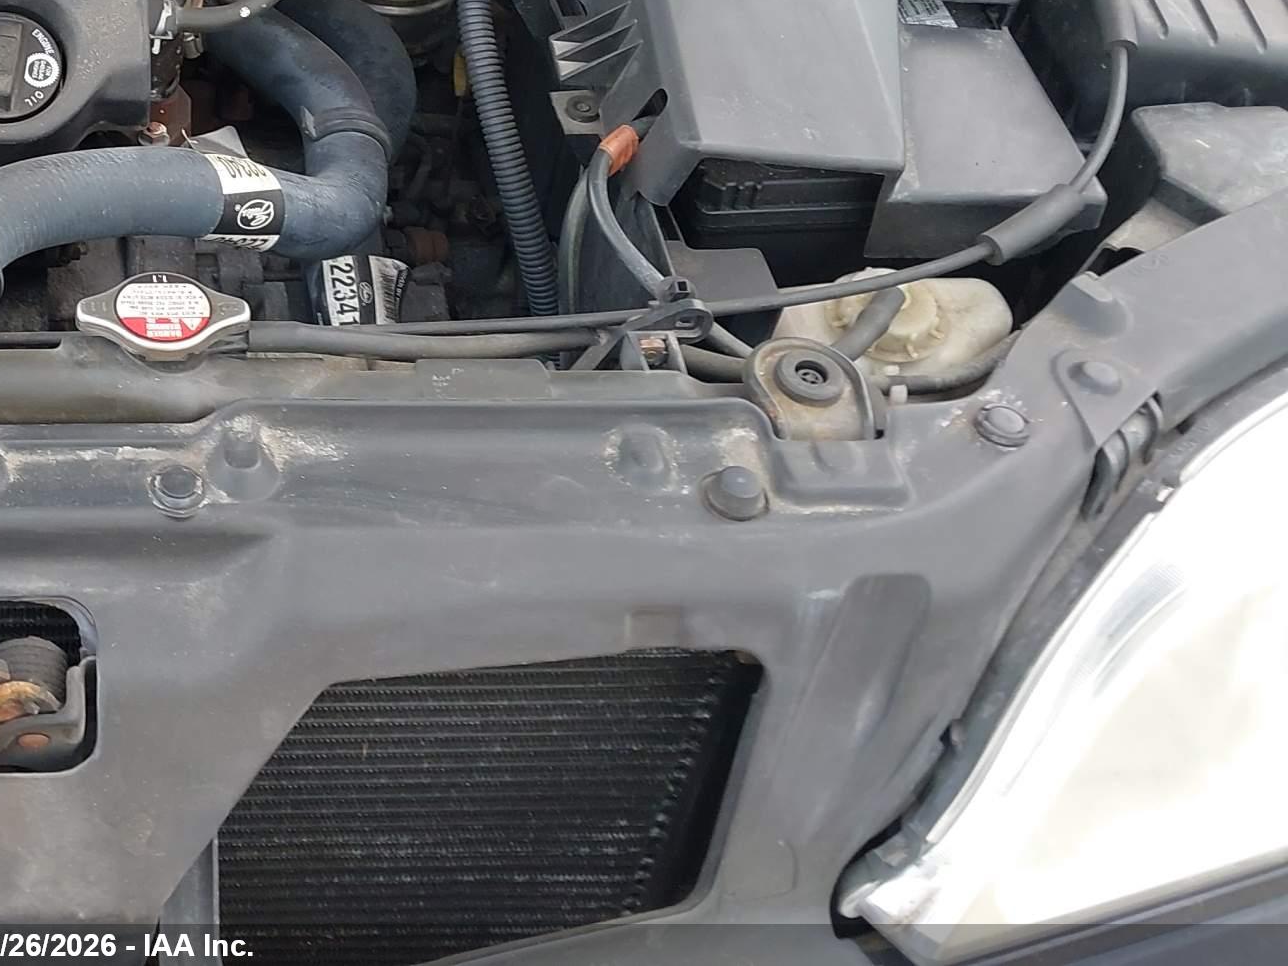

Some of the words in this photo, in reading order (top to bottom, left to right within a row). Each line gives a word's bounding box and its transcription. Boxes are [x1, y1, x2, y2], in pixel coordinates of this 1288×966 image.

[32, 28, 55, 55] ENGINE
[24, 90, 44, 107] OIL
[329, 263, 360, 326] 22341
